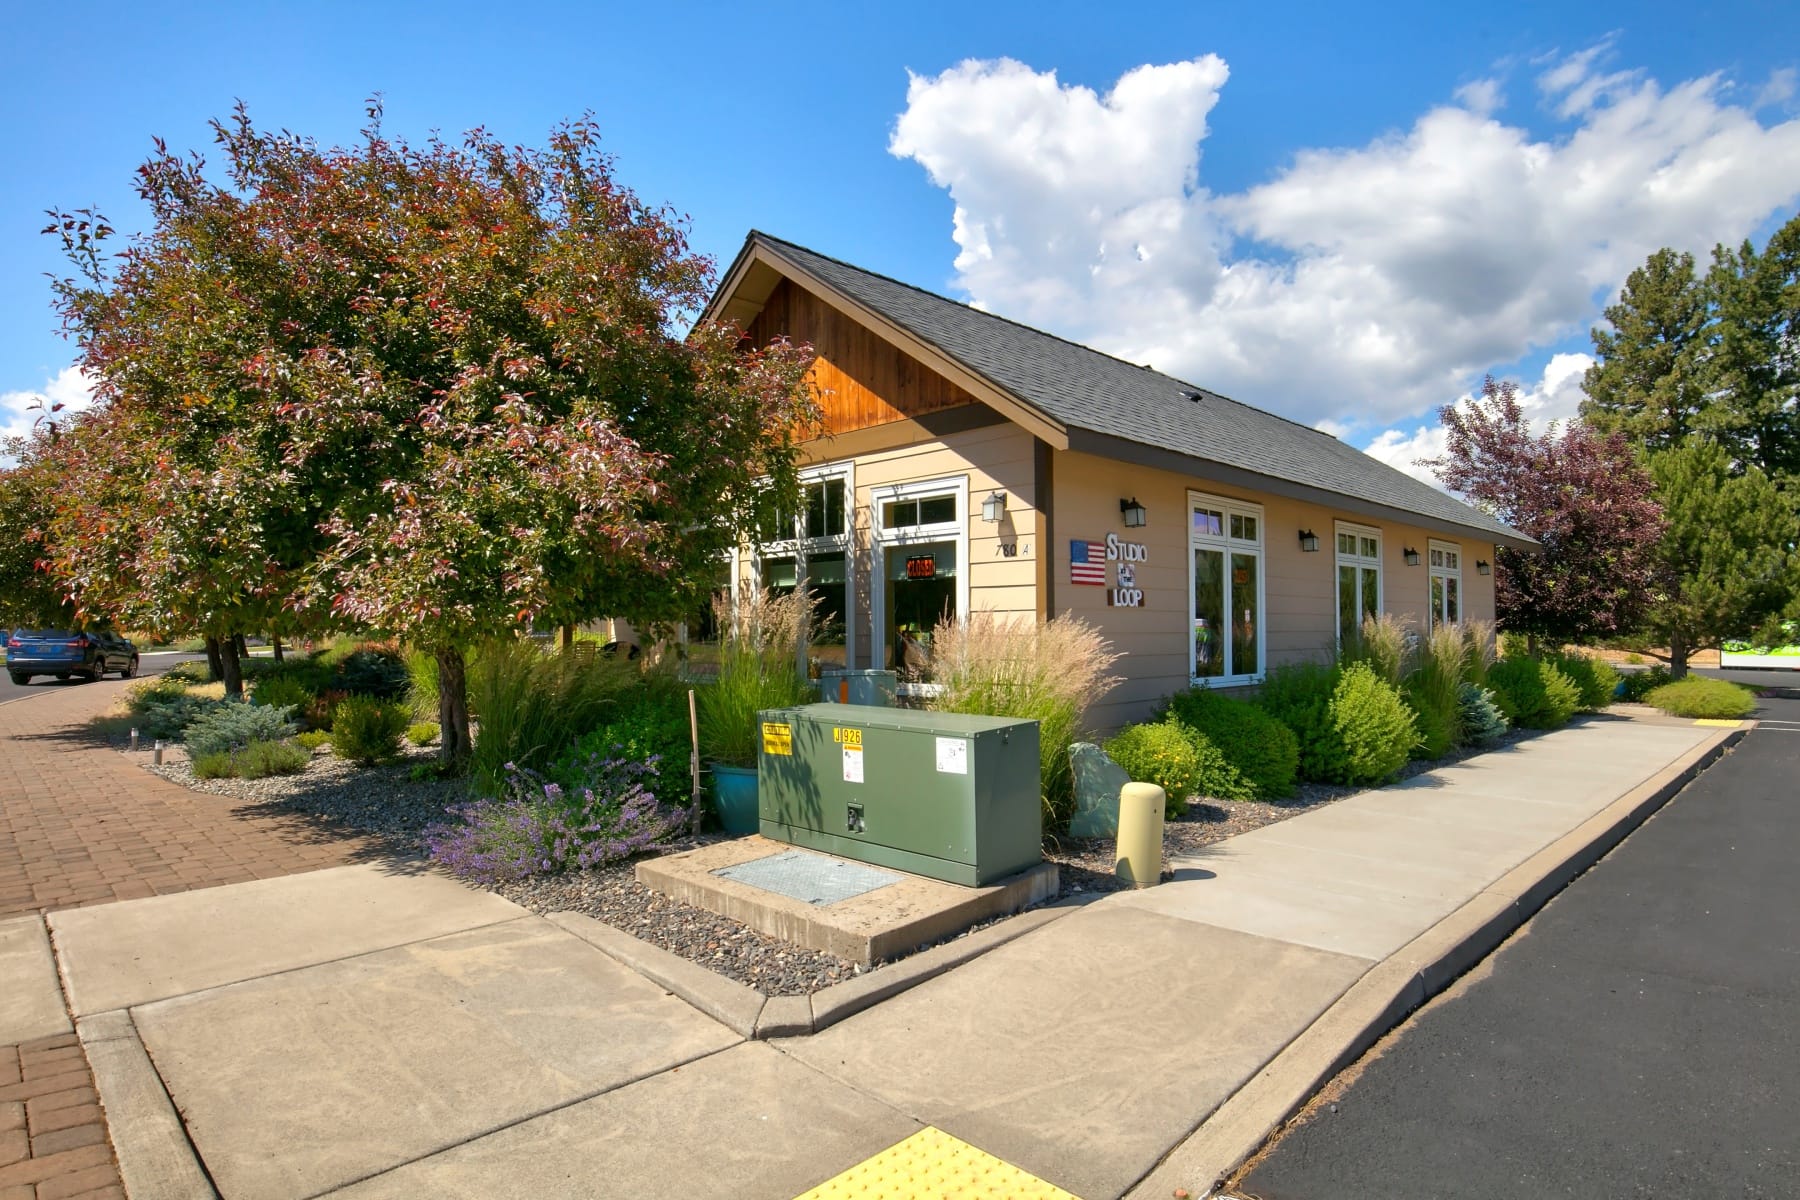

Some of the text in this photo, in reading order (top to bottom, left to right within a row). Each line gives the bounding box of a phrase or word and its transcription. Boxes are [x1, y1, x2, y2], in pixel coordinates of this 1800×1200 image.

[995, 543, 1017, 557] 780
[1107, 533, 1148, 562] STUDIO
[1113, 589, 1143, 607] LOOP
[843, 729, 861, 744] 926
